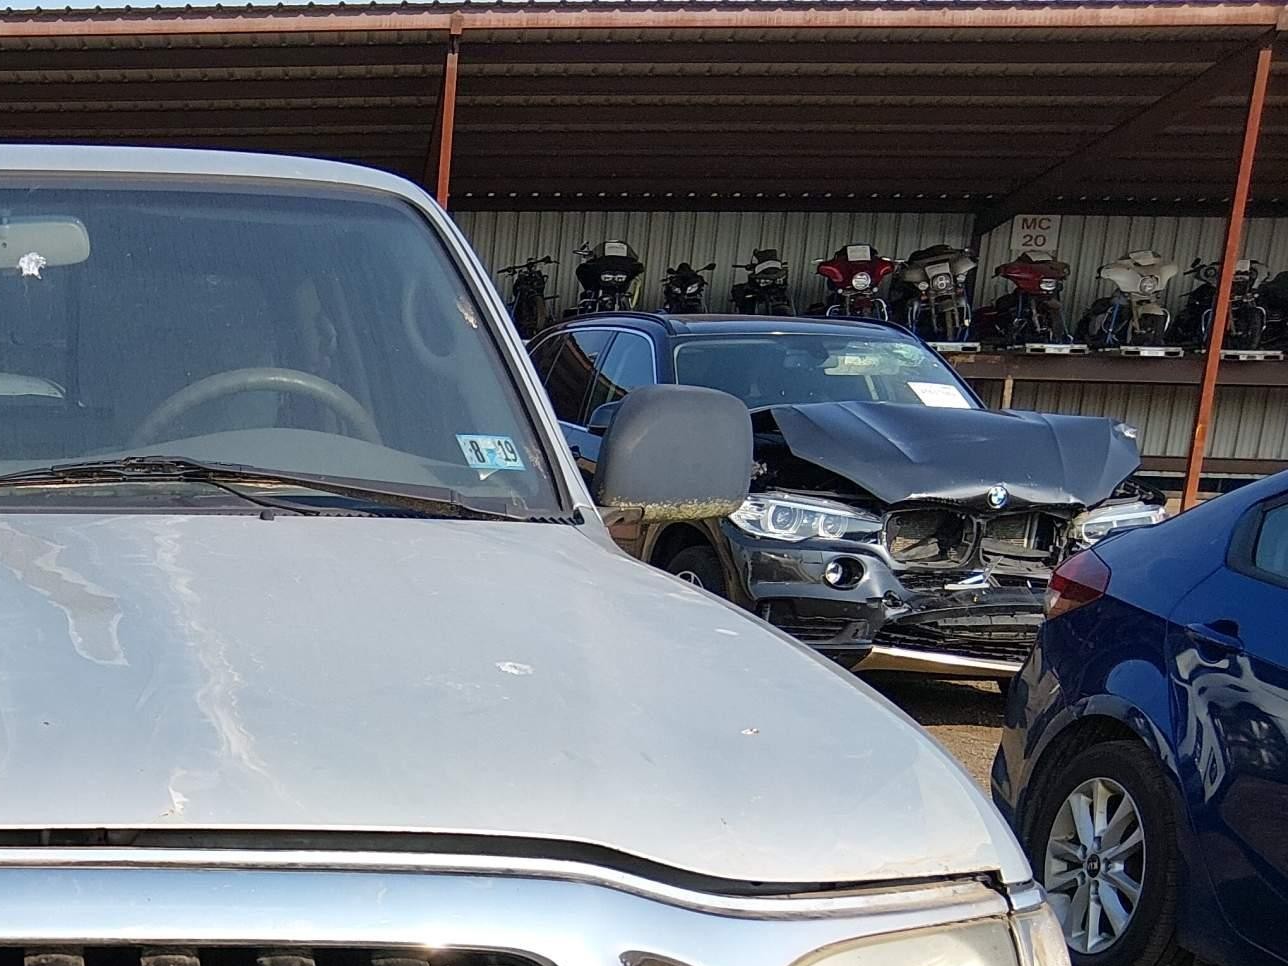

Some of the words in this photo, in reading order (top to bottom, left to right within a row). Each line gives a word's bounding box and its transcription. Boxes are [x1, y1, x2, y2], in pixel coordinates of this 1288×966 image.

[1021, 217, 1052, 230] MC
[1021, 234, 1046, 247] 20
[469, 440, 486, 463] 8
[497, 440, 518, 462] 19
